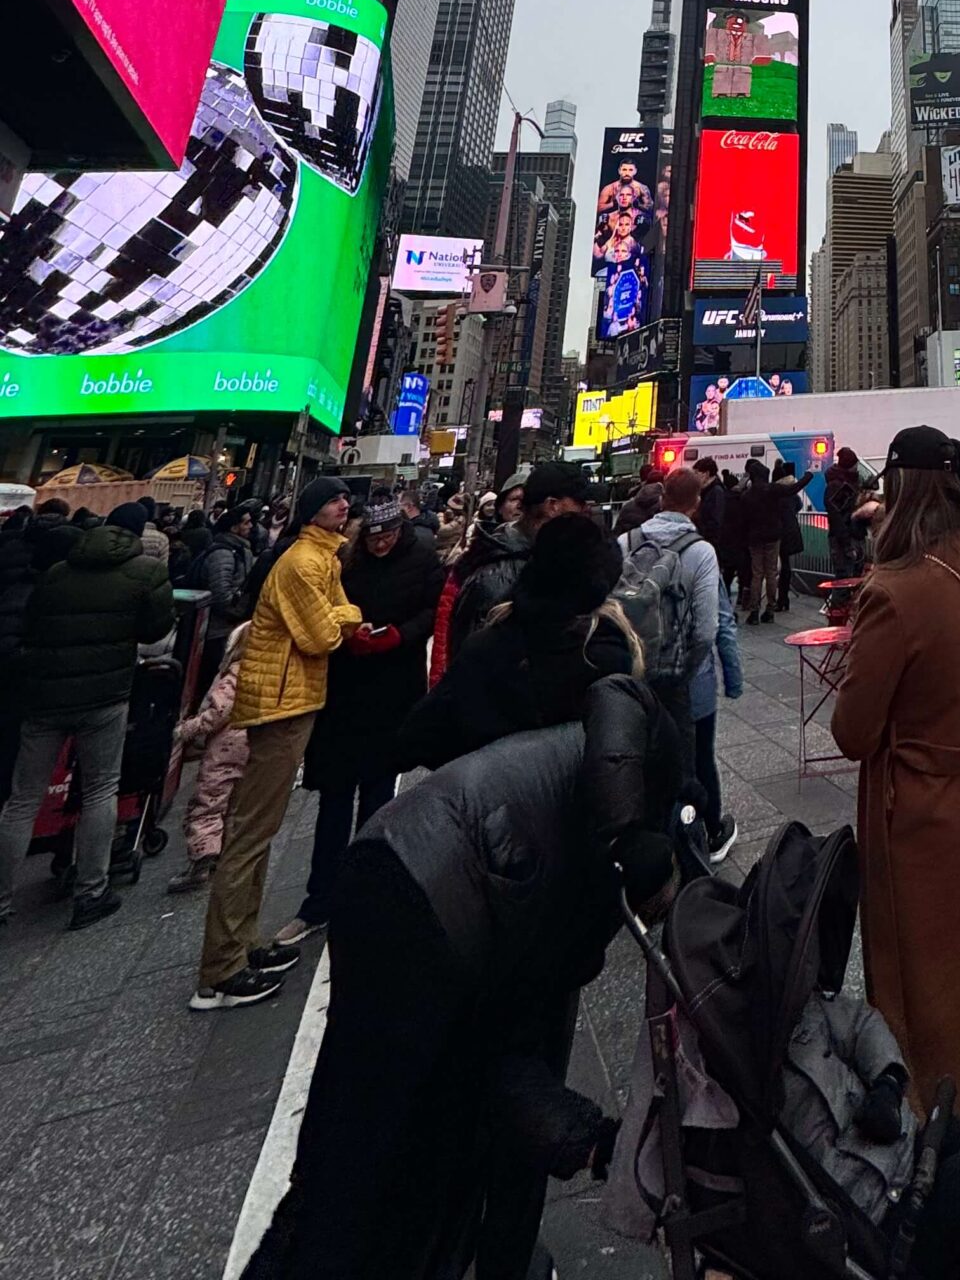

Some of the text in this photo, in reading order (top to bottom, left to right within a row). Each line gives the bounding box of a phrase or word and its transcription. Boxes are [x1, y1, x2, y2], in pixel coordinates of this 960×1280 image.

[619, 133, 644, 143] UFC
[702, 310, 739, 325] UFC
[734, 329, 766, 338] JANUAY
[512, 362, 522, 372] 46
[80, 368, 153, 395] bobbie
[213, 368, 279, 393] bobbie
